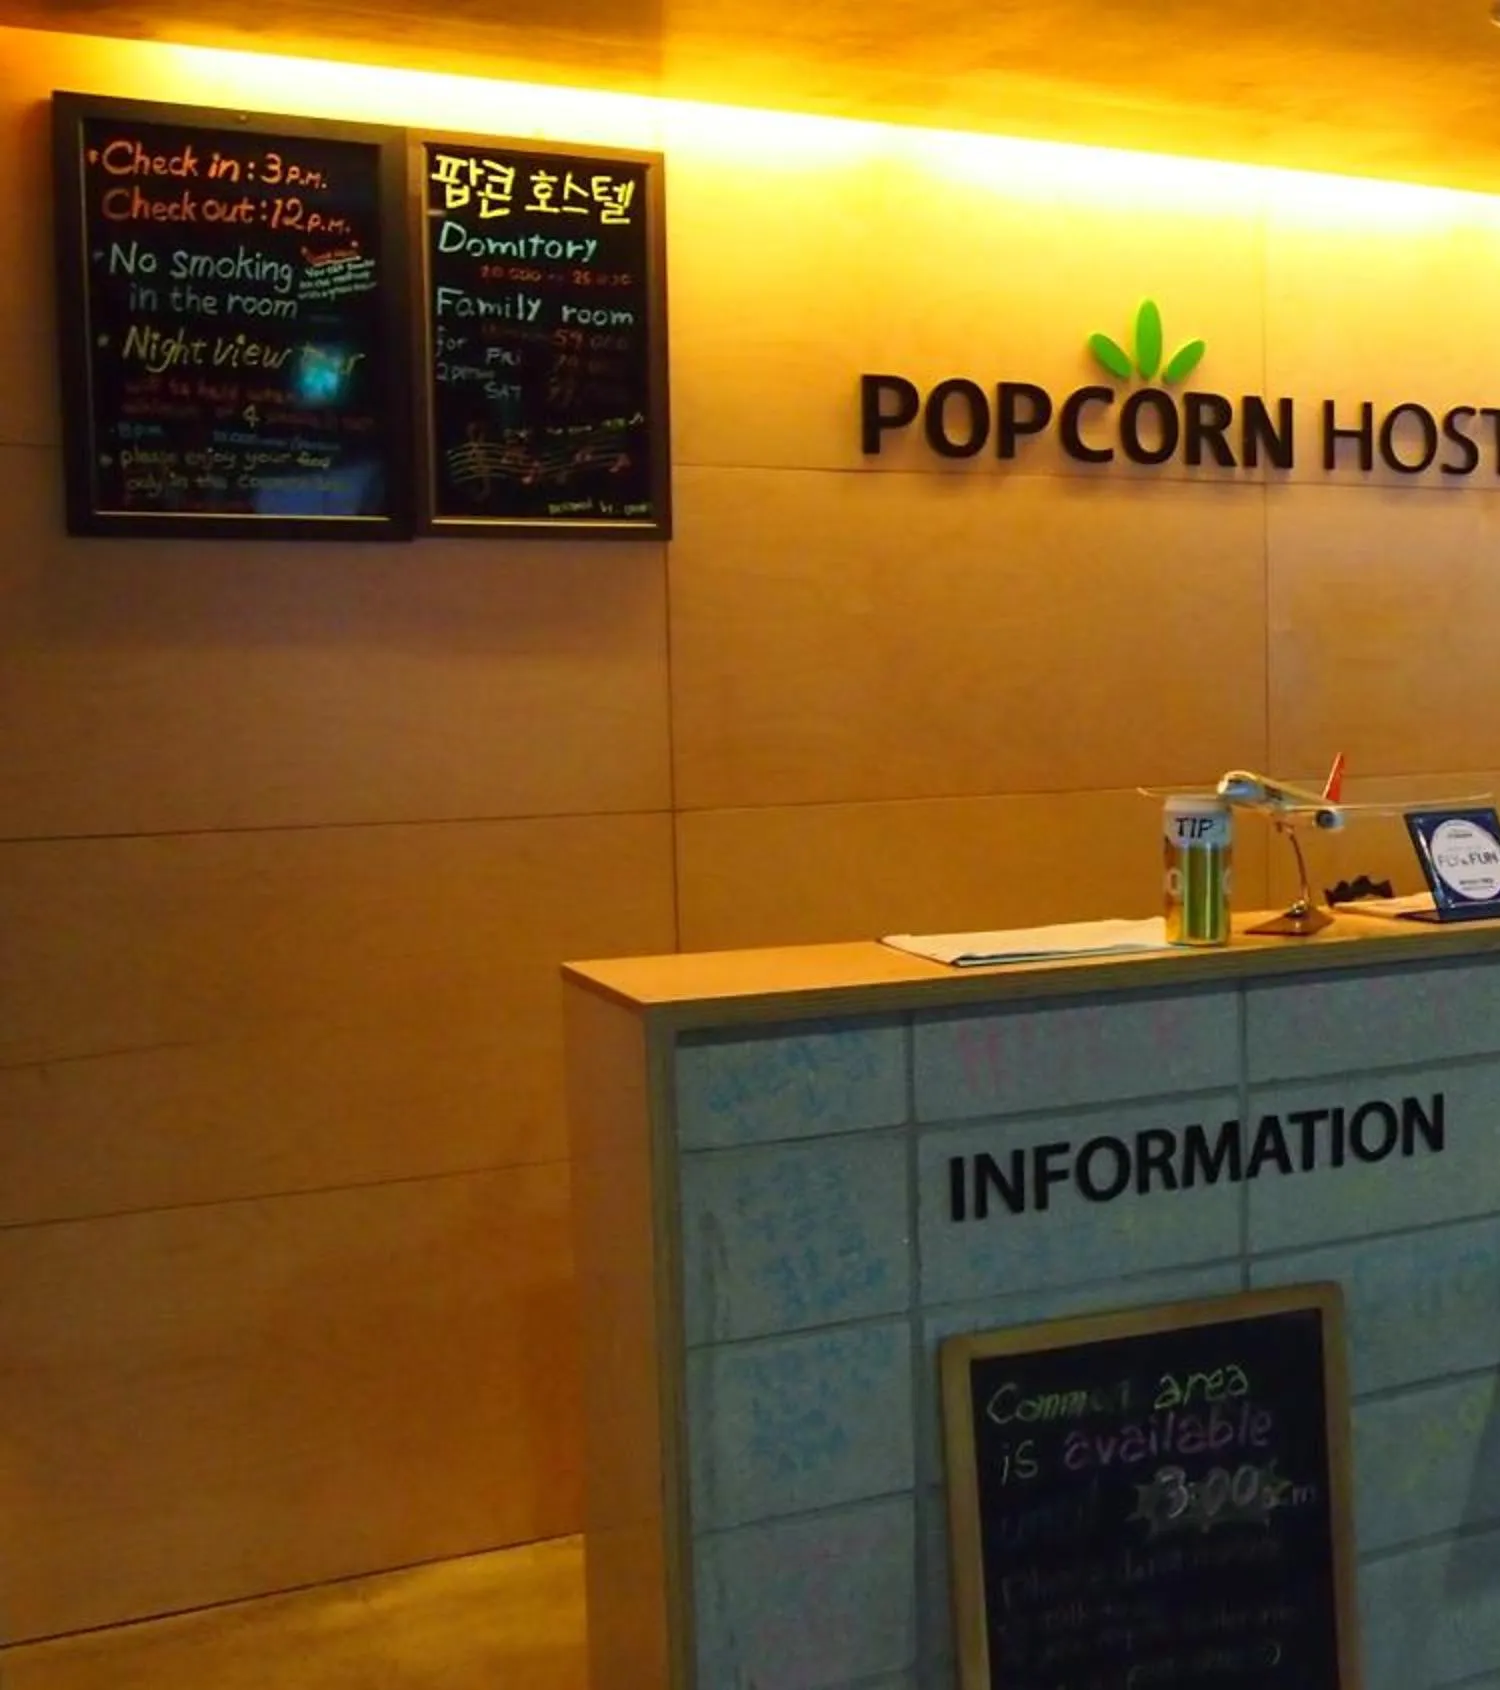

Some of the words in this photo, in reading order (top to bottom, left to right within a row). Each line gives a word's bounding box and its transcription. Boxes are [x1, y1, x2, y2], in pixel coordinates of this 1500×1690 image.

[102, 140, 198, 177] Check
[102, 187, 197, 222] Check
[431, 154, 515, 218] 팝콘
[524, 170, 635, 224] 호스텔
[109, 240, 157, 275] No
[129, 282, 158, 313] in
[169, 285, 219, 316] the
[226, 292, 299, 320] room
[436, 285, 542, 321] Family
[561, 304, 634, 325] room
[121, 325, 207, 374] Night
[212, 332, 293, 369] view
[860, 374, 1294, 469] POPCORN
[1175, 817, 1214, 838] TIP
[948, 1093, 1445, 1222] INFORMATION
[1153, 1364, 1249, 1410] area
[1000, 1439, 1039, 1488] is
[1064, 1400, 1273, 1472] available
